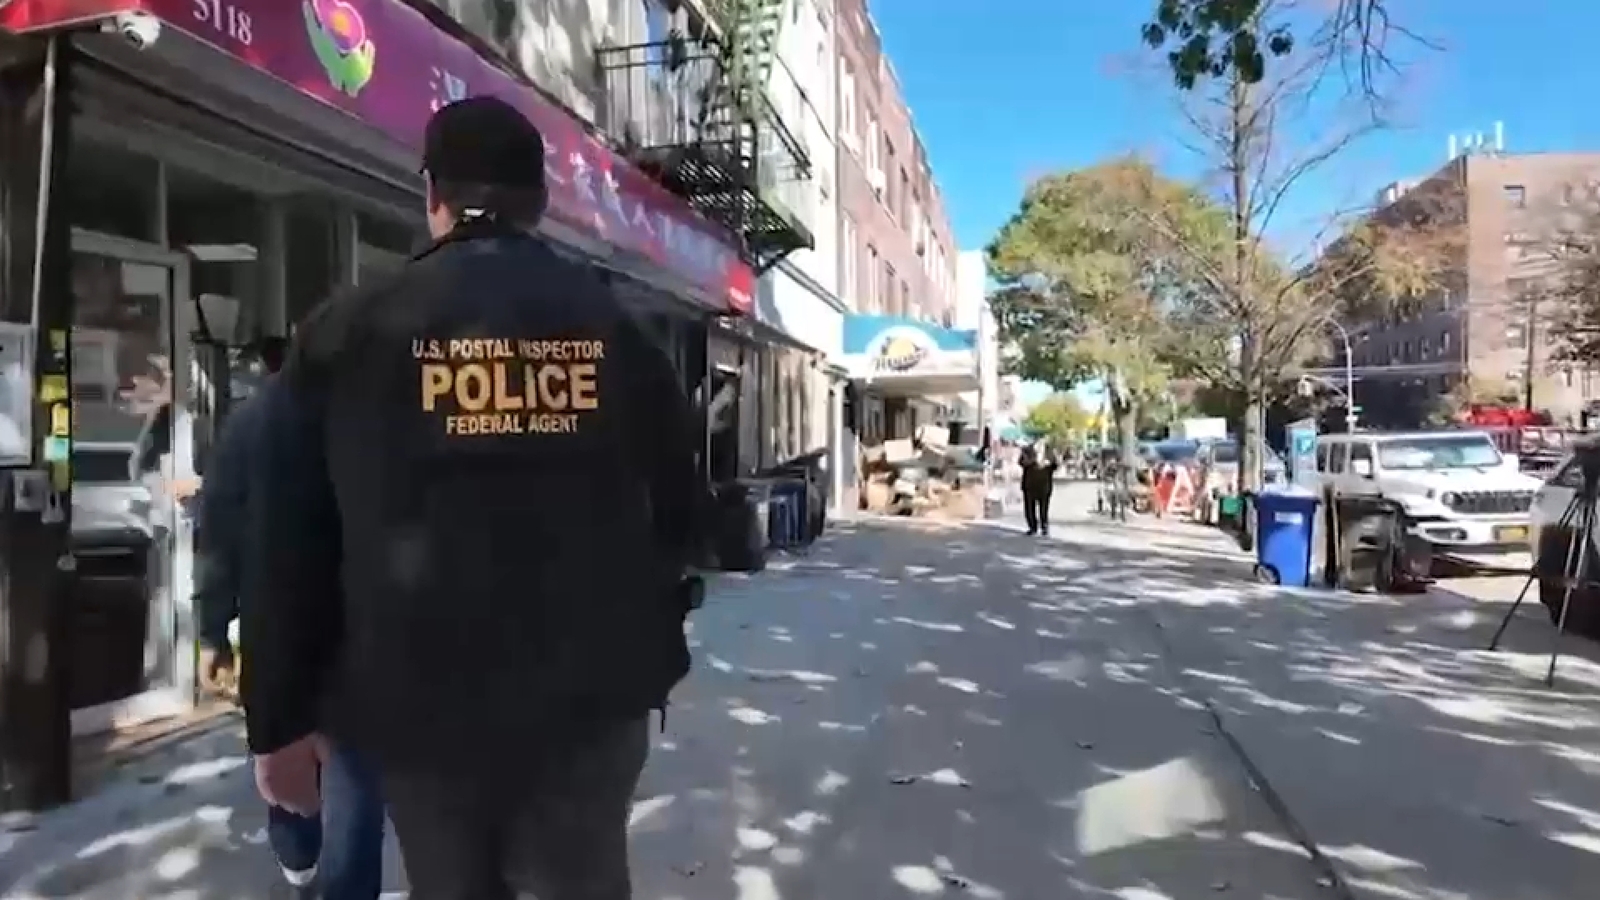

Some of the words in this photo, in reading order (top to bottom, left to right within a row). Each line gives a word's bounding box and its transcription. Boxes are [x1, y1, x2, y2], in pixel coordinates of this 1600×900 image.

[412, 337, 445, 359] U.S.
[451, 338, 514, 359] POSTAL
[421, 363, 598, 412] POLICE
[446, 413, 523, 435] FEDERAL
[528, 413, 578, 434] AGENT
